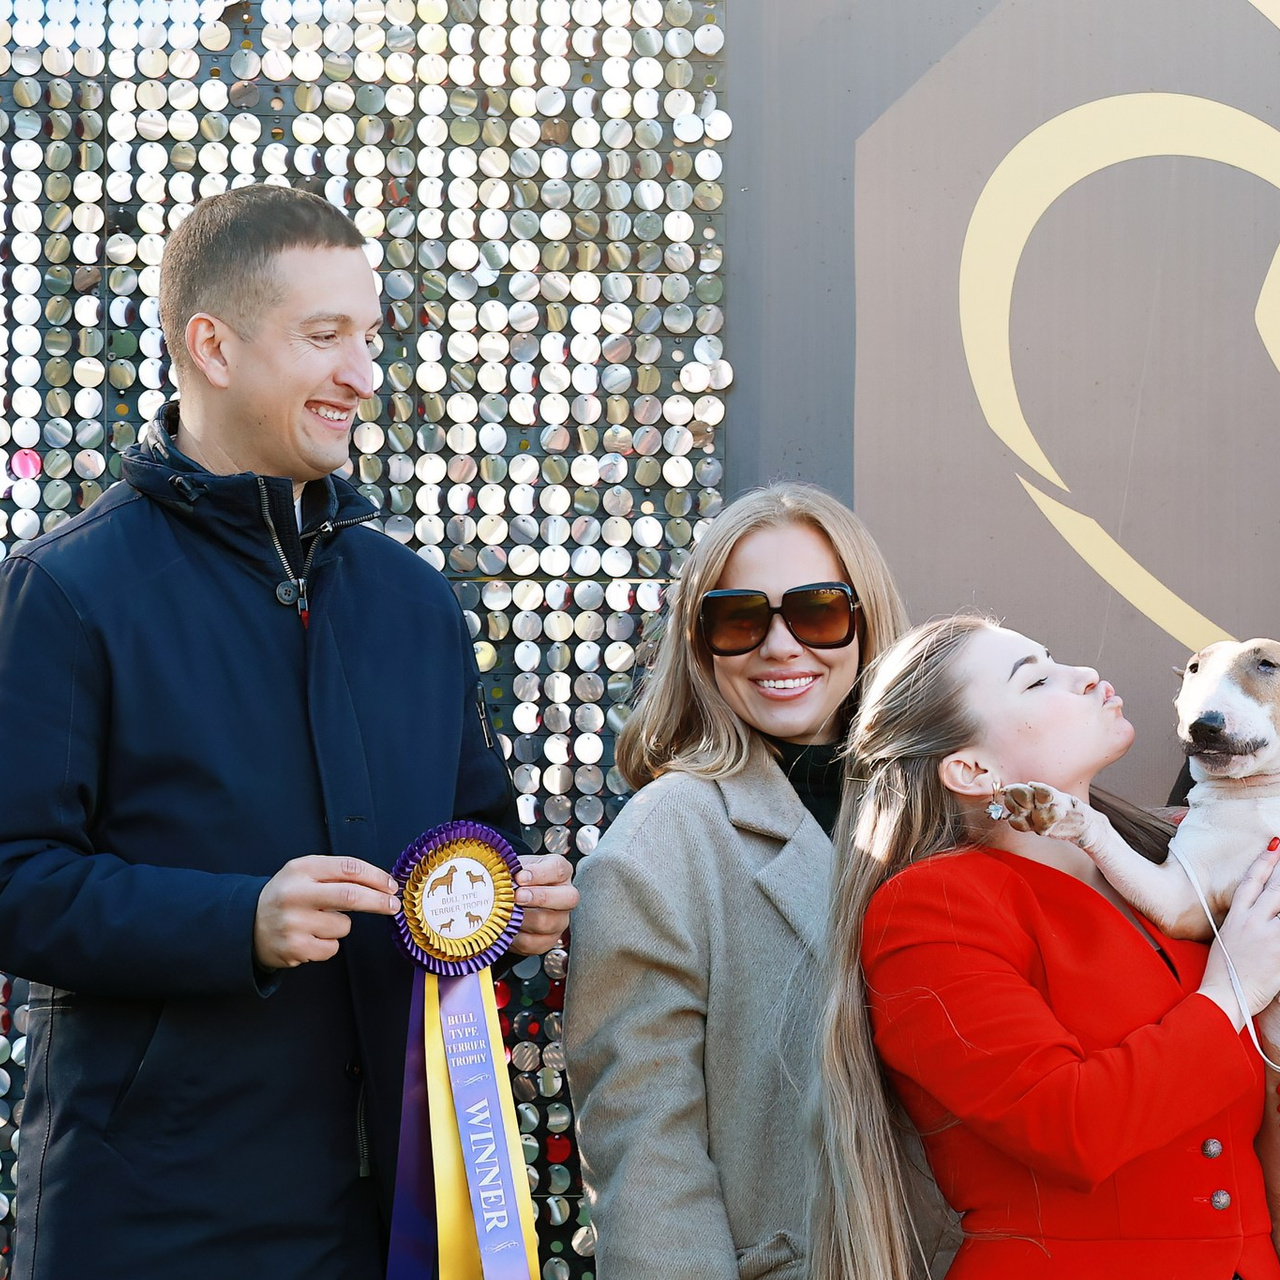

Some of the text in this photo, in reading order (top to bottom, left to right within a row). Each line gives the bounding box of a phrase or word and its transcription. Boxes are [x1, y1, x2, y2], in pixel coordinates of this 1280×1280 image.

[441, 891, 478, 905] BULL TYPE
[430, 899, 489, 917] TERRIER TROPHY
[447, 1012, 477, 1026] BULL
[449, 1026, 479, 1040] TYPE
[446, 1039, 487, 1054] TERRIER
[451, 1053, 487, 1068] TROPHY
[465, 1097, 510, 1233] WINNER
